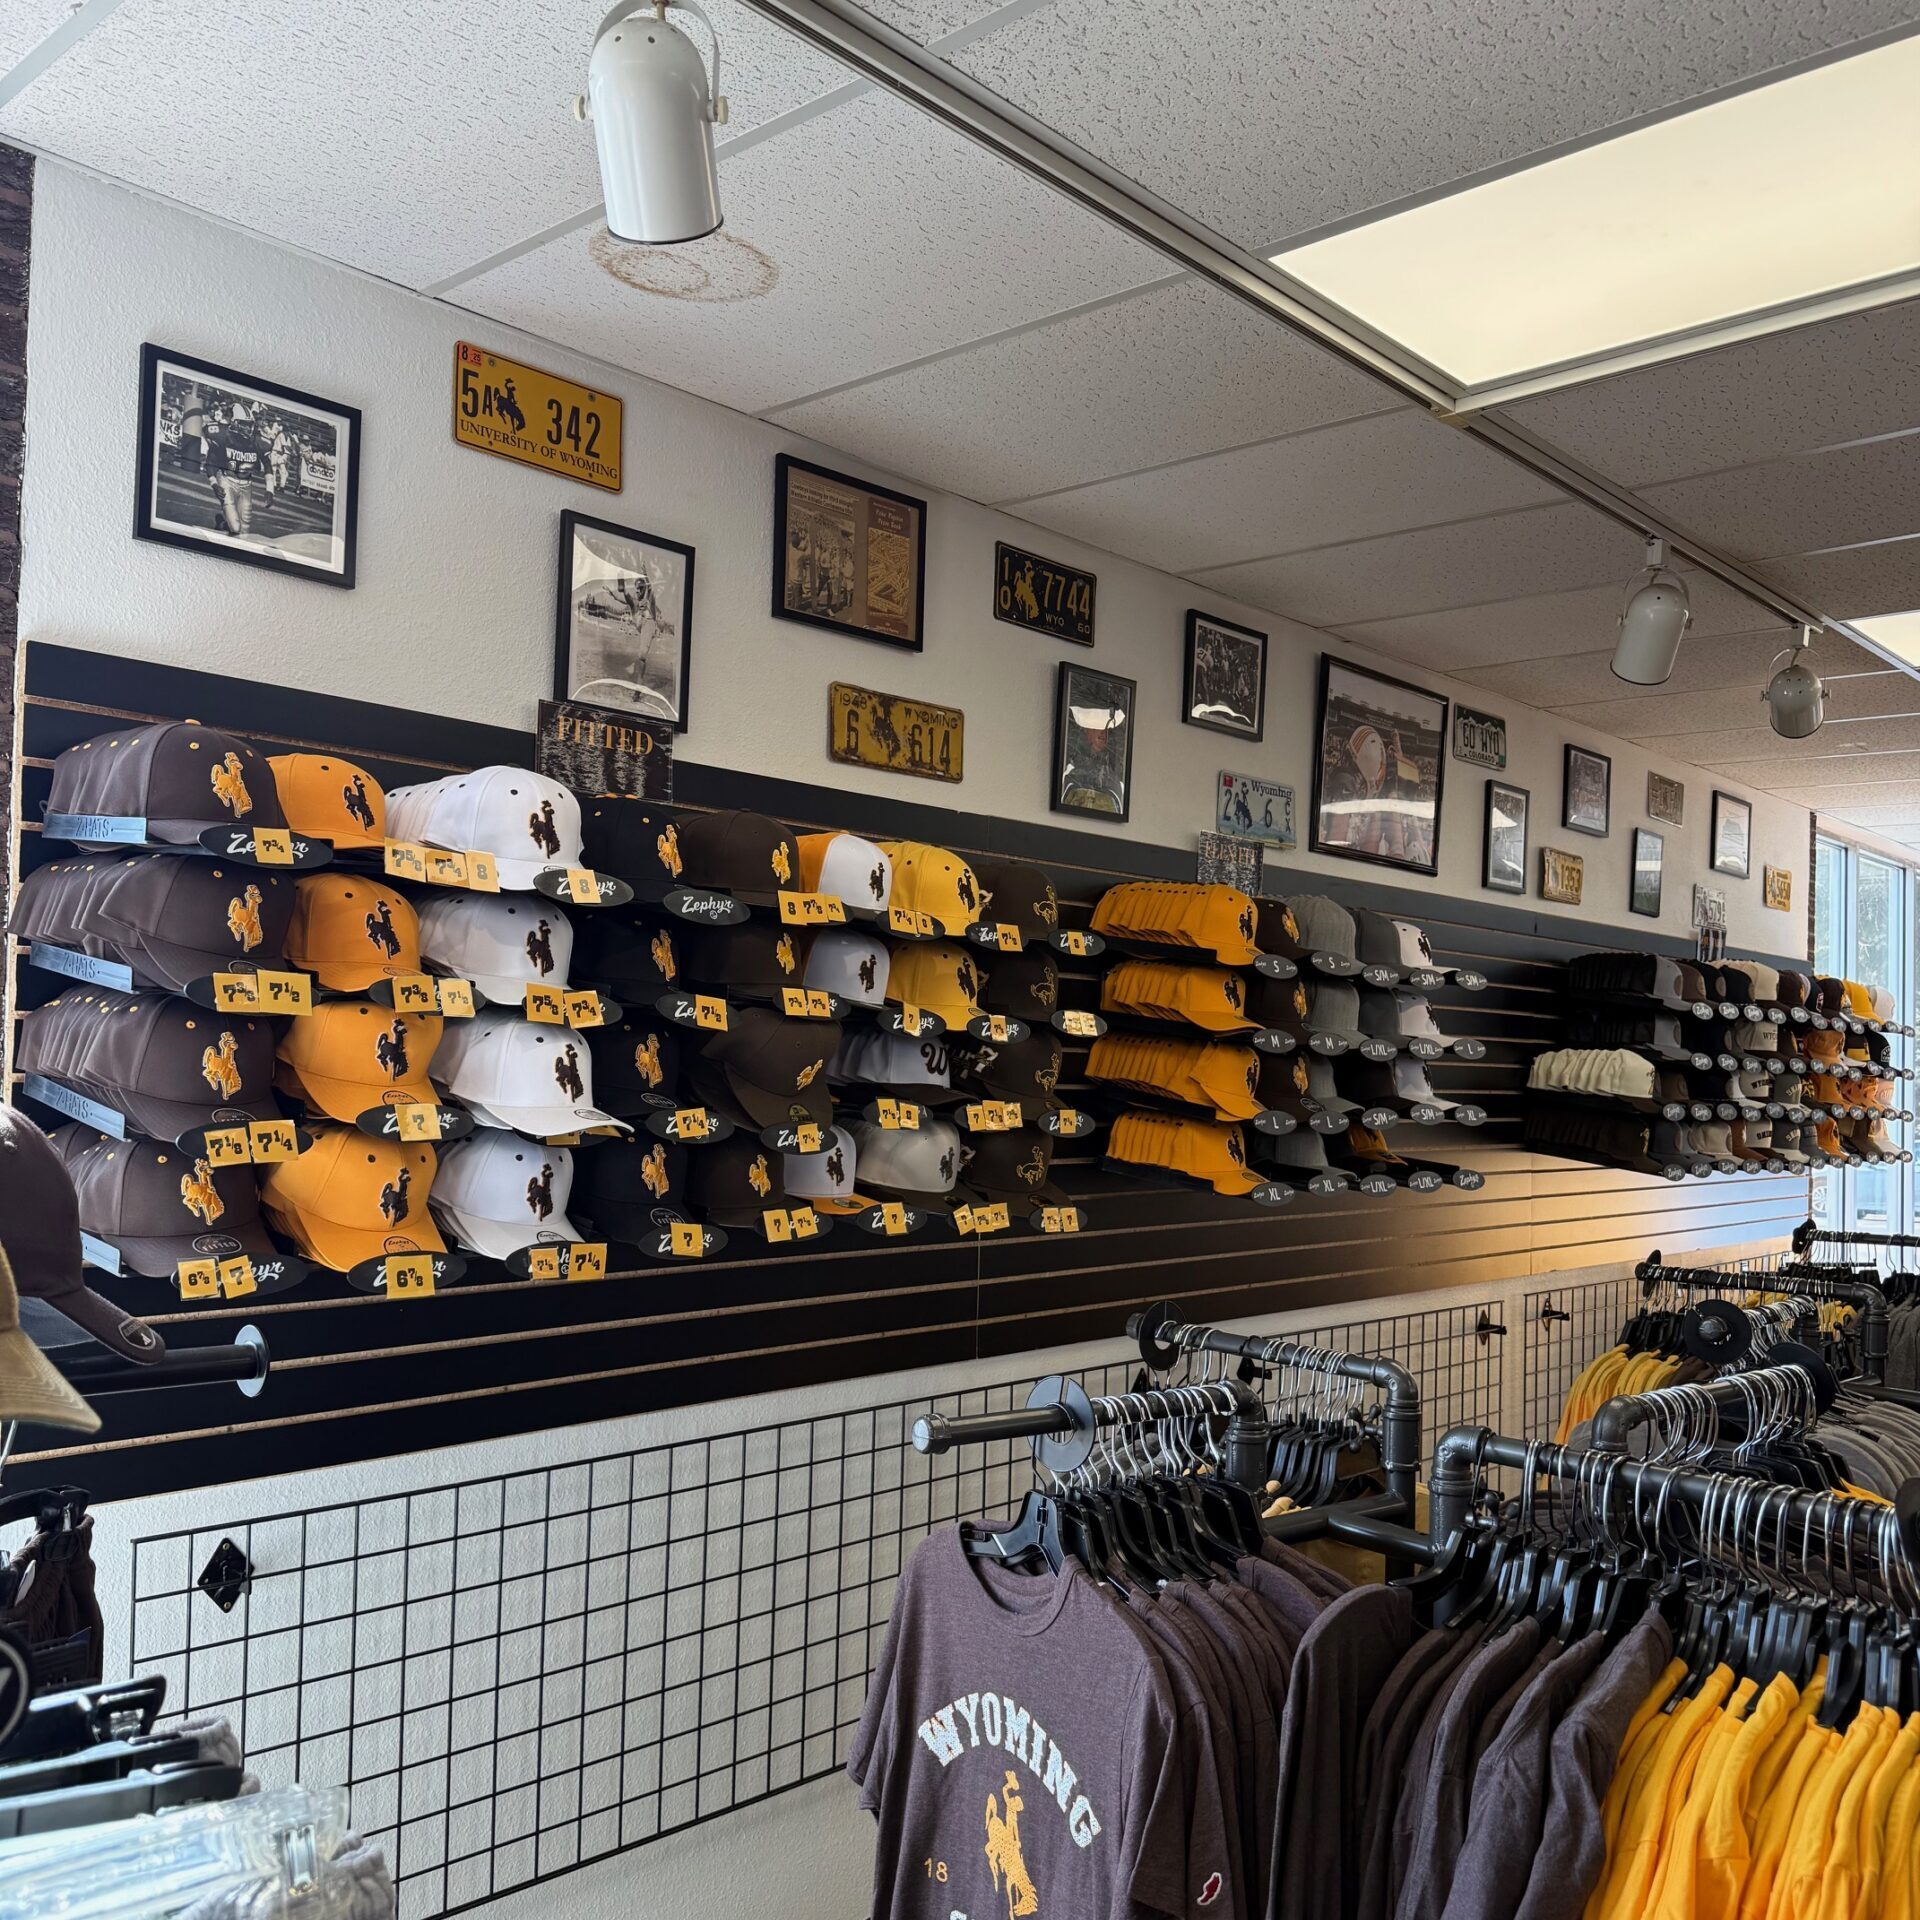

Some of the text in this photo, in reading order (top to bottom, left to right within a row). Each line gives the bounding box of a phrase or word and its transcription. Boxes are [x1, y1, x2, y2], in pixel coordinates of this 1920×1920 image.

[461, 345, 468, 360] 8
[473, 353, 481, 362] 25
[546, 399, 600, 459] 342
[226, 447, 257, 462] WYOMING
[460, 419, 618, 479] UNIVERSITY OF WYOMING
[1043, 570, 1090, 621] 7744
[1045, 612, 1065, 627] WYO
[904, 706, 959, 730] WYOMING
[556, 715, 654, 756] FITTED
[844, 709, 951, 774] 6 614
[1463, 722, 1500, 756] GO WYO
[1251, 779, 1293, 803] Wyoming
[1223, 788, 1233, 821] 2
[1264, 798, 1273, 828] 6
[477, 864, 488, 880] 8
[580, 879, 590, 894] 8
[681, 896, 734, 914] Zephyr
[788, 902, 796, 915] 8
[1274, 960, 1280, 973] S
[1329, 956, 1335, 969] S
[1271, 1035, 1280, 1047] M
[1325, 1037, 1334, 1049] M
[1467, 1043, 1474, 1055] L
[1272, 1116, 1279, 1129] L
[1326, 1115, 1333, 1128] L
[1466, 1110, 1477, 1120] XL
[1323, 1180, 1335, 1192] XL
[1268, 1187, 1281, 1201] XL
[683, 1232, 693, 1247] 7
[229, 1266, 245, 1285] 7
[918, 1691, 1102, 1849] WYOMING
[924, 1857, 949, 1883] 18
